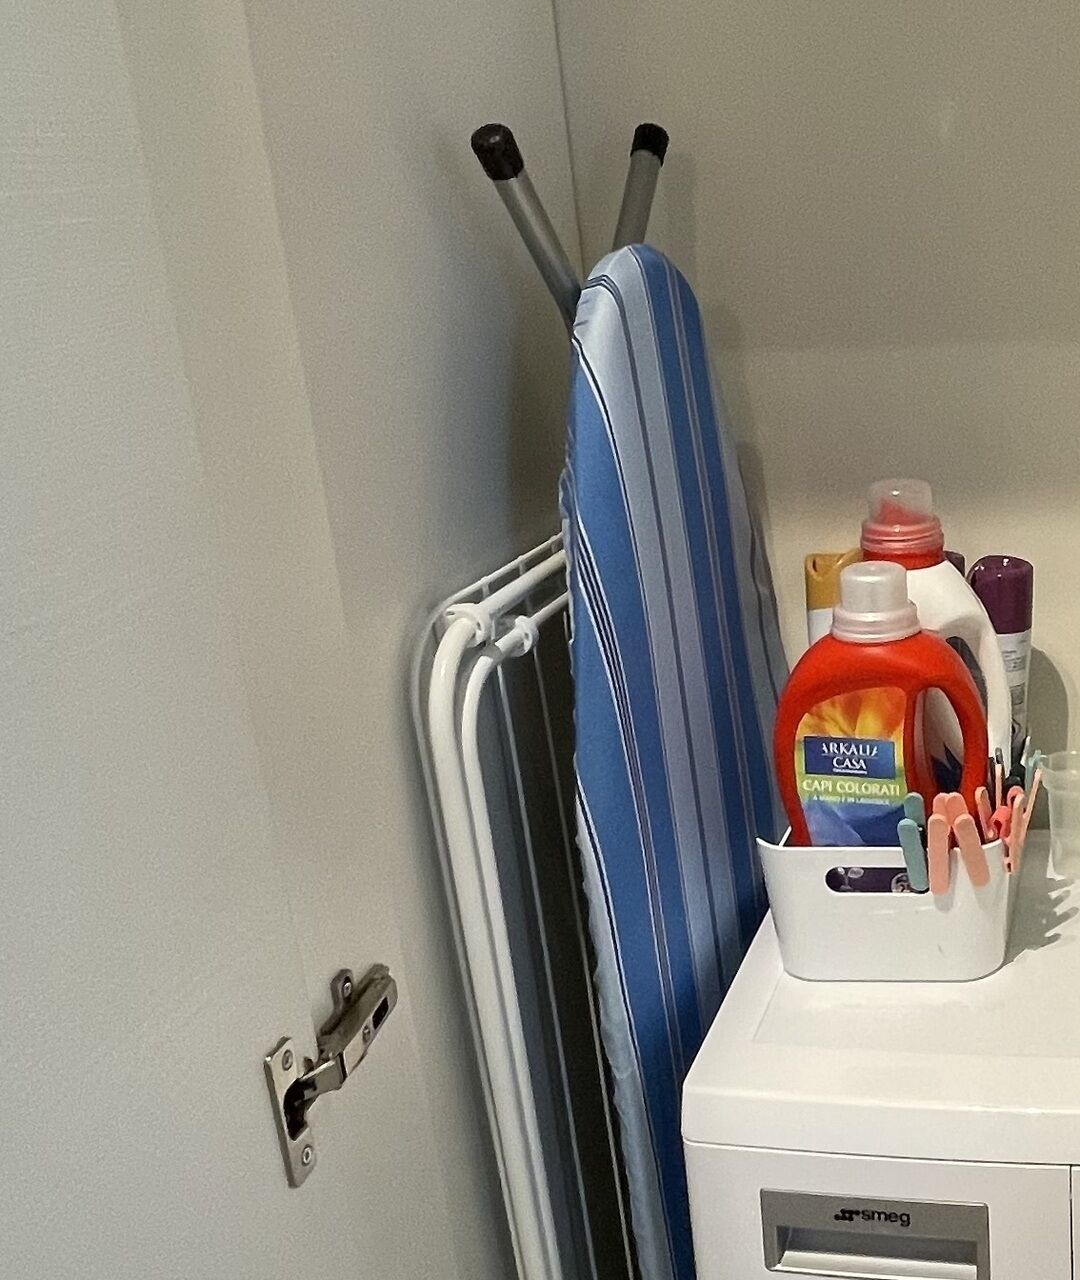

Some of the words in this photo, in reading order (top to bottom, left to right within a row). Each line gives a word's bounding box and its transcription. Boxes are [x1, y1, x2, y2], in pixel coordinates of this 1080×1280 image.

[832, 756, 867, 769] CASA
[802, 779, 833, 793] CAPI
[836, 781, 900, 796] COLORATI
[861, 1208, 911, 1227] smeg
